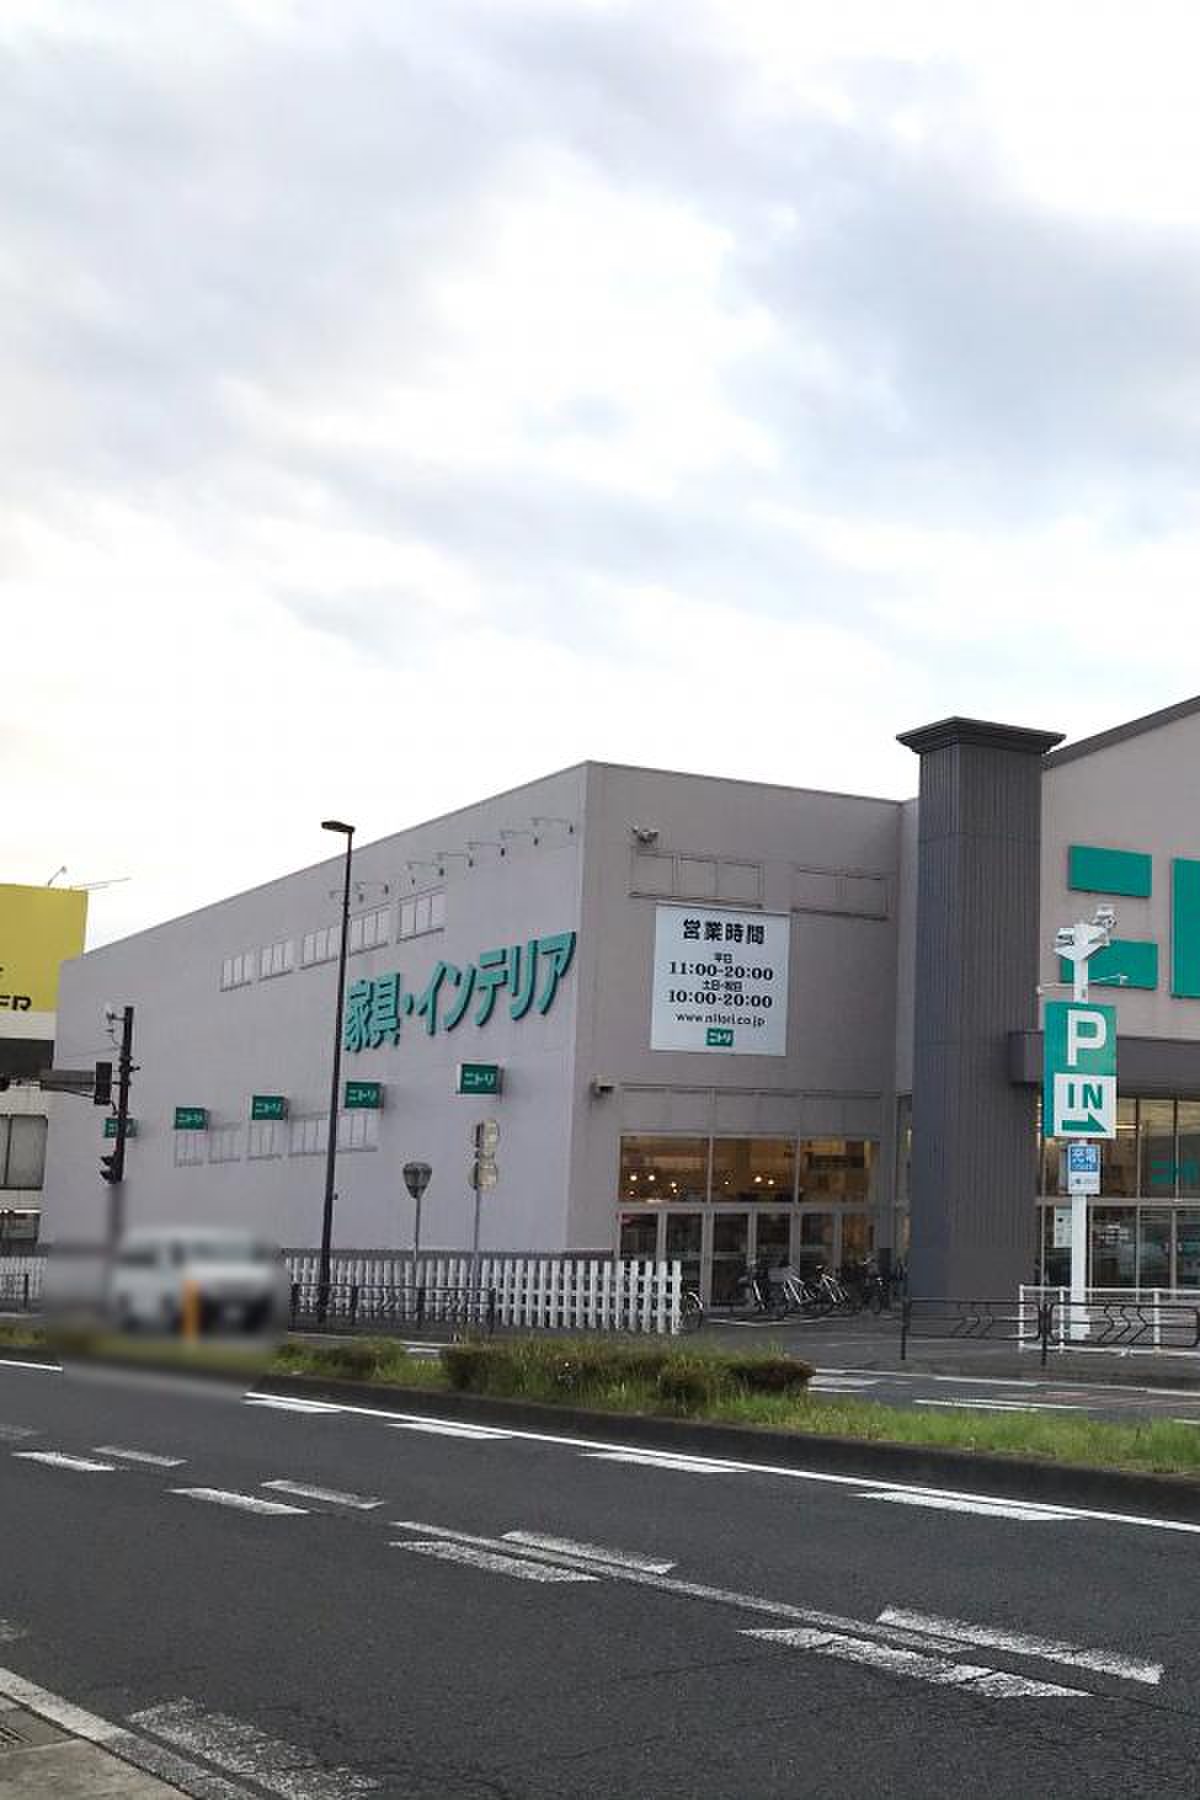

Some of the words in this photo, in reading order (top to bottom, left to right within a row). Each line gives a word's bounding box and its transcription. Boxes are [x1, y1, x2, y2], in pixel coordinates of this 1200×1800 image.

[683, 919, 765, 945] 営業時間
[344, 931, 577, 1054] 家具・インテリア
[1067, 1008, 1107, 1067] P
[463, 1071, 496, 1087] ニトリ
[348, 1087, 377, 1102] ニトリ
[1067, 1083, 1103, 1109] IN
[254, 1102, 282, 1114] ニトリ
